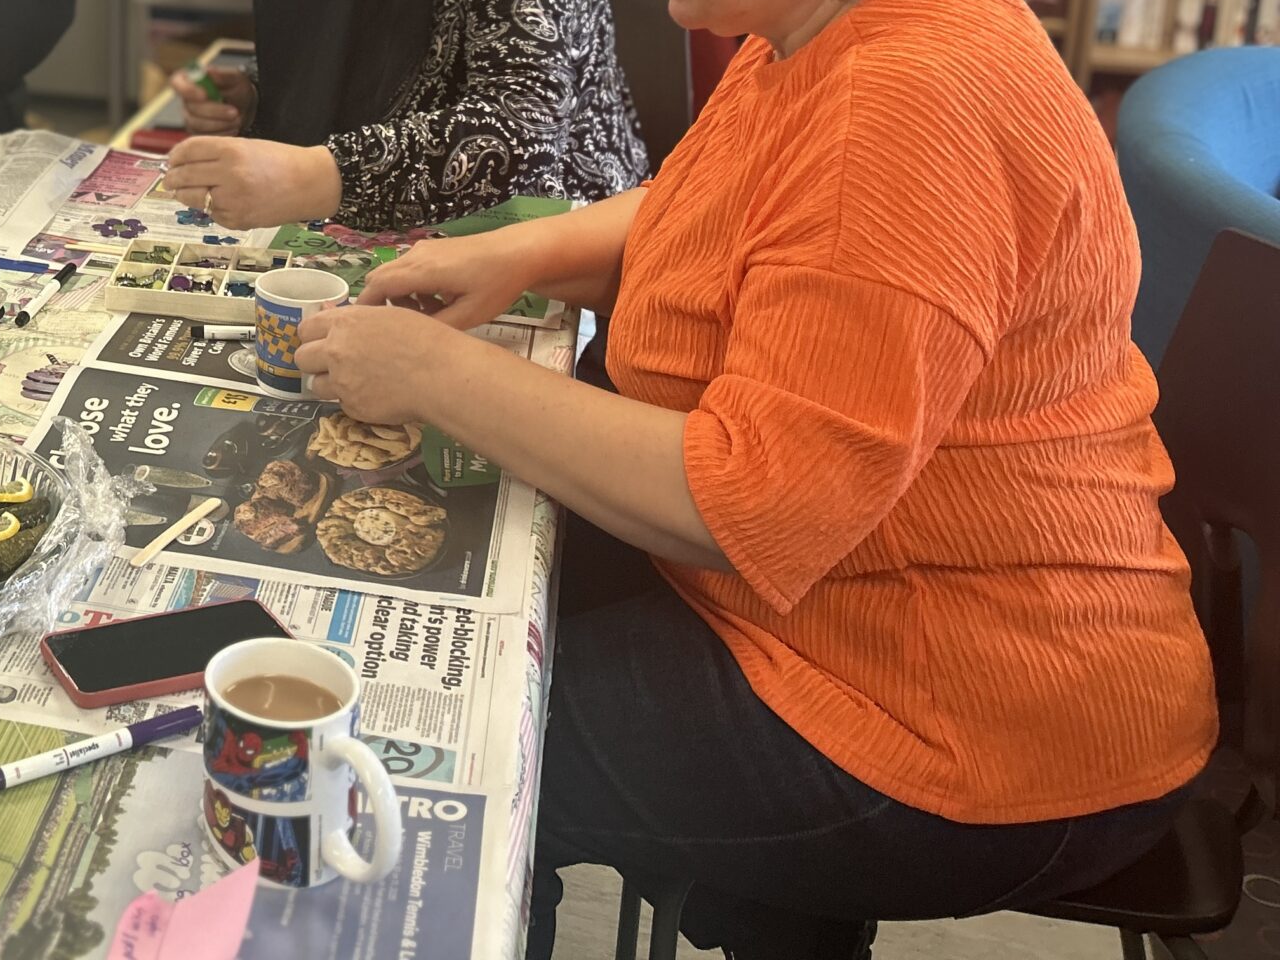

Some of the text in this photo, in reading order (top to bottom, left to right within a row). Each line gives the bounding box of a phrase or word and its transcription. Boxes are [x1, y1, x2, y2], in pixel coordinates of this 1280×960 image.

[128, 342, 148, 358] Own
[143, 318, 166, 342] Britain's
[144, 319, 184, 361] World Famous
[181, 345, 204, 367] Silver
[124, 382, 160, 408] they
[48, 396, 110, 470] Cose
[109, 410, 140, 442] what
[127, 402, 181, 455] love.
[361, 594, 397, 679] clear option
[389, 599, 423, 662] nd taking
[420, 605, 449, 671] n's power
[441, 607, 476, 691] ed-blocking,
[69, 742, 100, 759] specialist
[409, 830, 433, 898] Wimbledon
[443, 822, 467, 873] TRAVEL
[403, 899, 423, 937] Tennis
